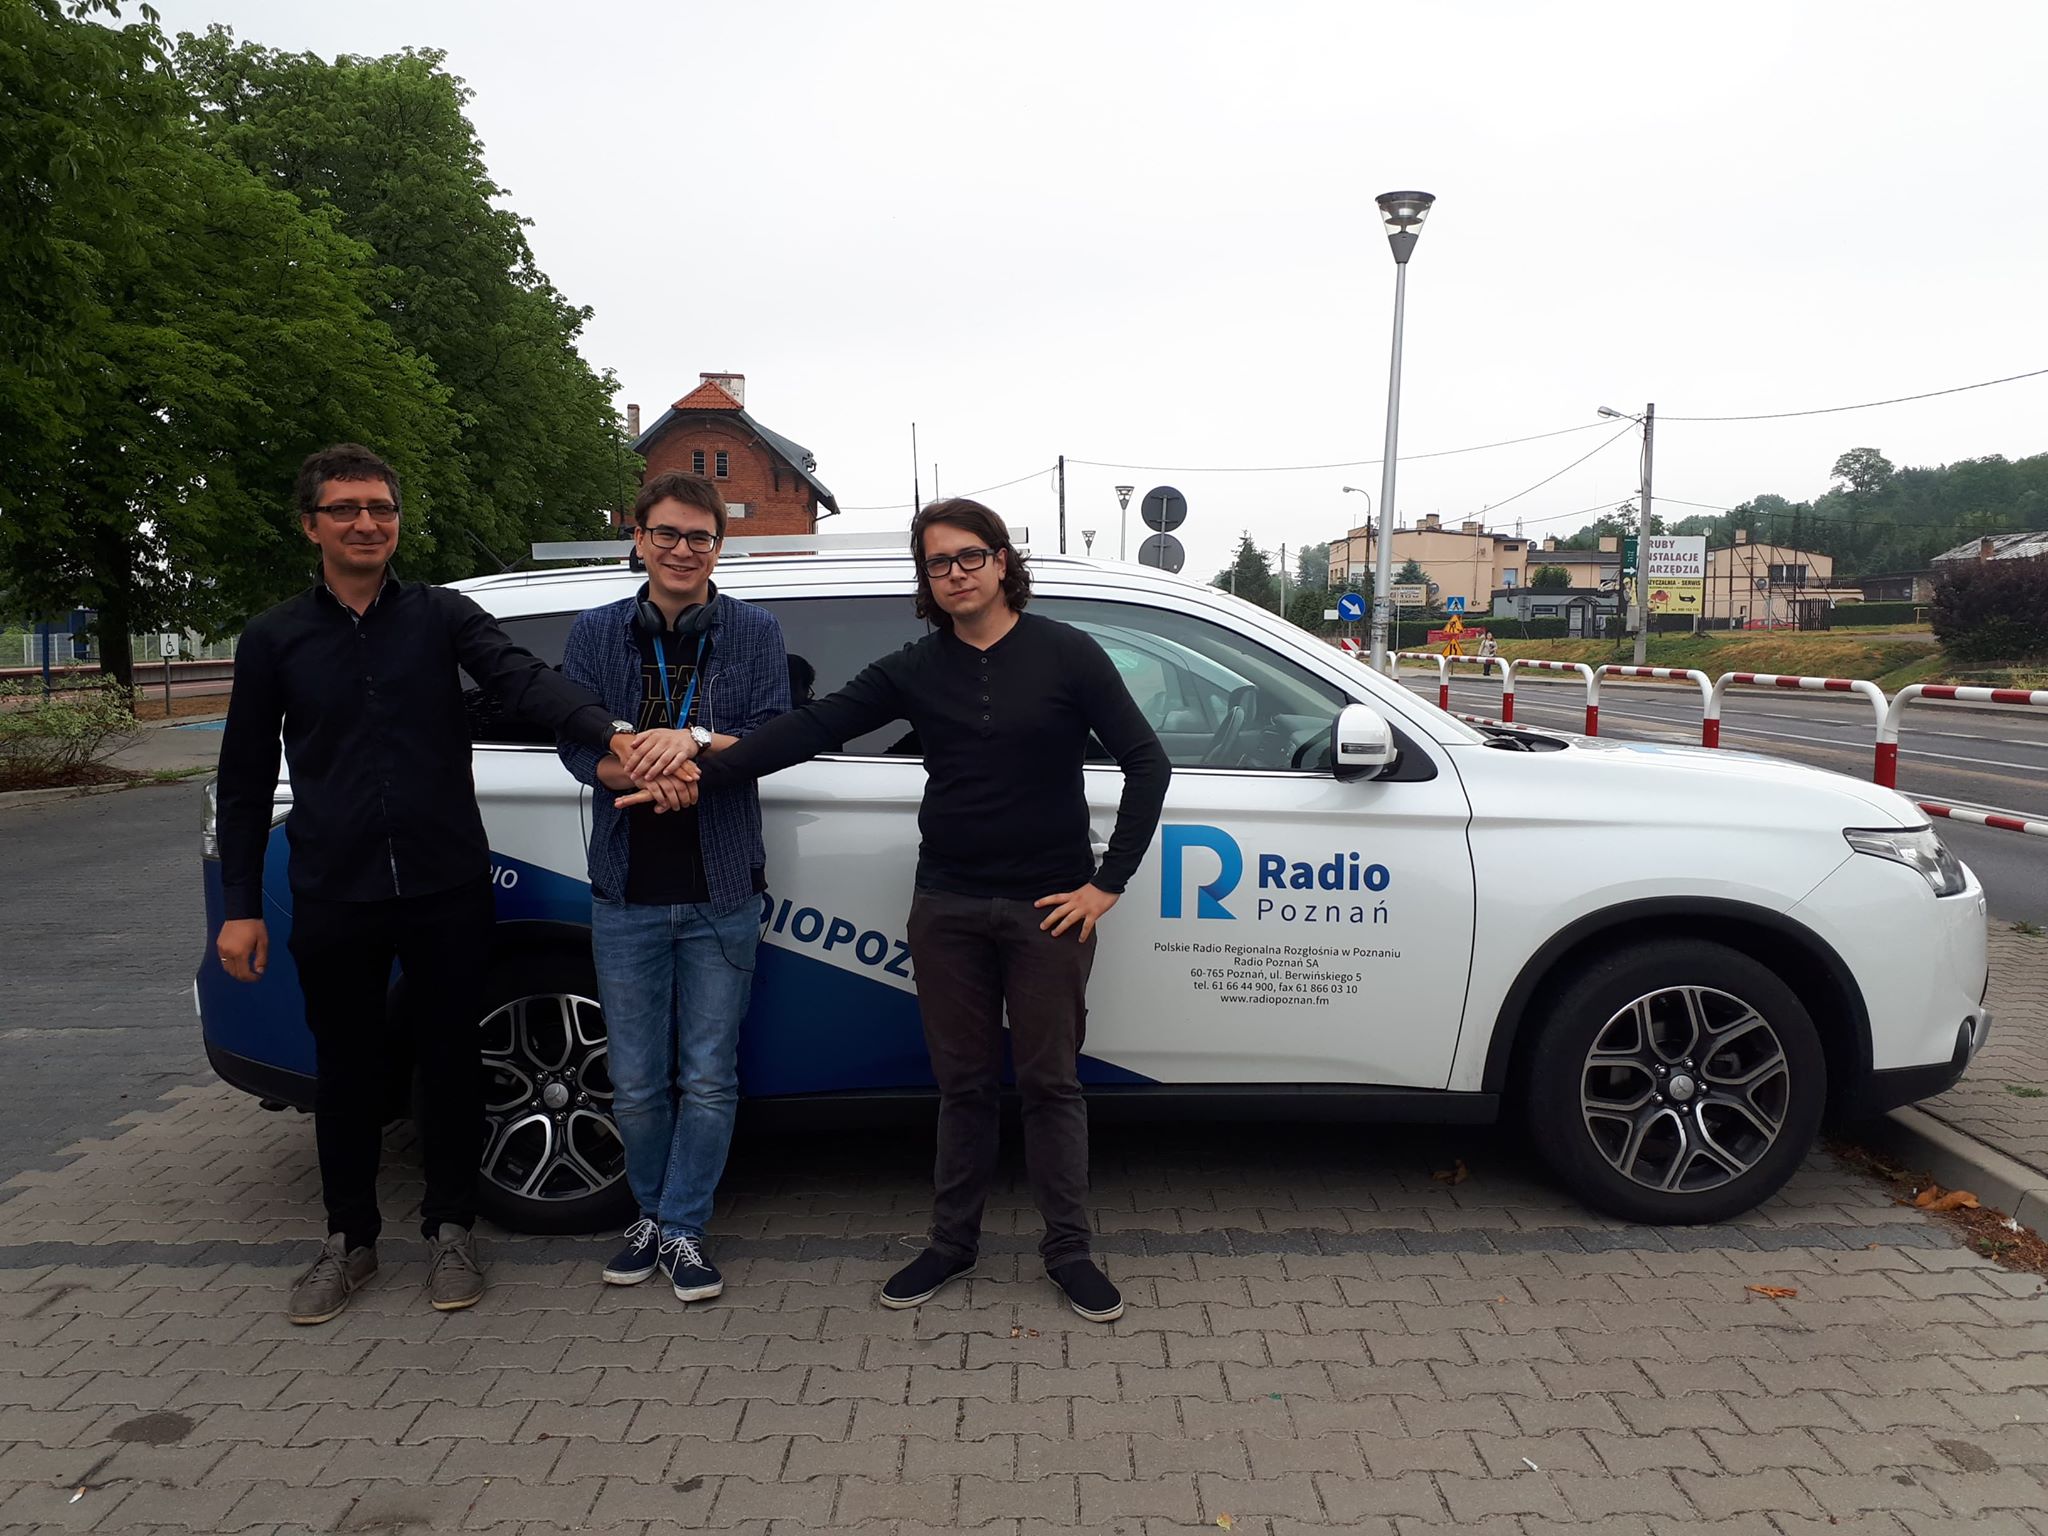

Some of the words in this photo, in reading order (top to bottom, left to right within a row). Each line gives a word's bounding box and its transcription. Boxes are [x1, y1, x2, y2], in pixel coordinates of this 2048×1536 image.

[1648, 540, 1675, 549] RUBY
[1648, 552, 1699, 562] NSTALACJE
[1648, 565, 1700, 576] ARZĘDZIA
[641, 665, 703, 699] TA
[490, 864, 518, 889] IO
[1160, 824, 1243, 920] R
[1258, 851, 1391, 892] Radio
[1257, 898, 1389, 924] Poznań
[1154, 942, 1190, 952] Polskie
[1192, 943, 1222, 953] Radio
[1224, 944, 1281, 956] Regionalna
[1284, 945, 1339, 958] Rozgłośnia
[1341, 948, 1351, 956] w
[1353, 947, 1401, 958] Poznaniu
[1233, 957, 1263, 966] Radio
[1265, 957, 1303, 968] Poznań
[1305, 958, 1319, 968] SA
[1190, 968, 1224, 978] 60-765
[1269, 970, 1282, 979] ul.
[1285, 970, 1353, 983] Berwińskiego
[1355, 972, 1362, 982] 5
[1193, 981, 1210, 990] tel.
[1211, 981, 1223, 990] 61
[1226, 981, 1238, 991] 66
[1240, 982, 1253, 991] 44
[1255, 982, 1276, 992] 900,
[1278, 982, 1293, 992] fax
[1295, 983, 1307, 993] 61
[1310, 984, 1328, 993] 866
[1330, 984, 1343, 994] 03
[1346, 985, 1358, 994] 10
[1220, 994, 1329, 1006] www.radiopoznan.fm
